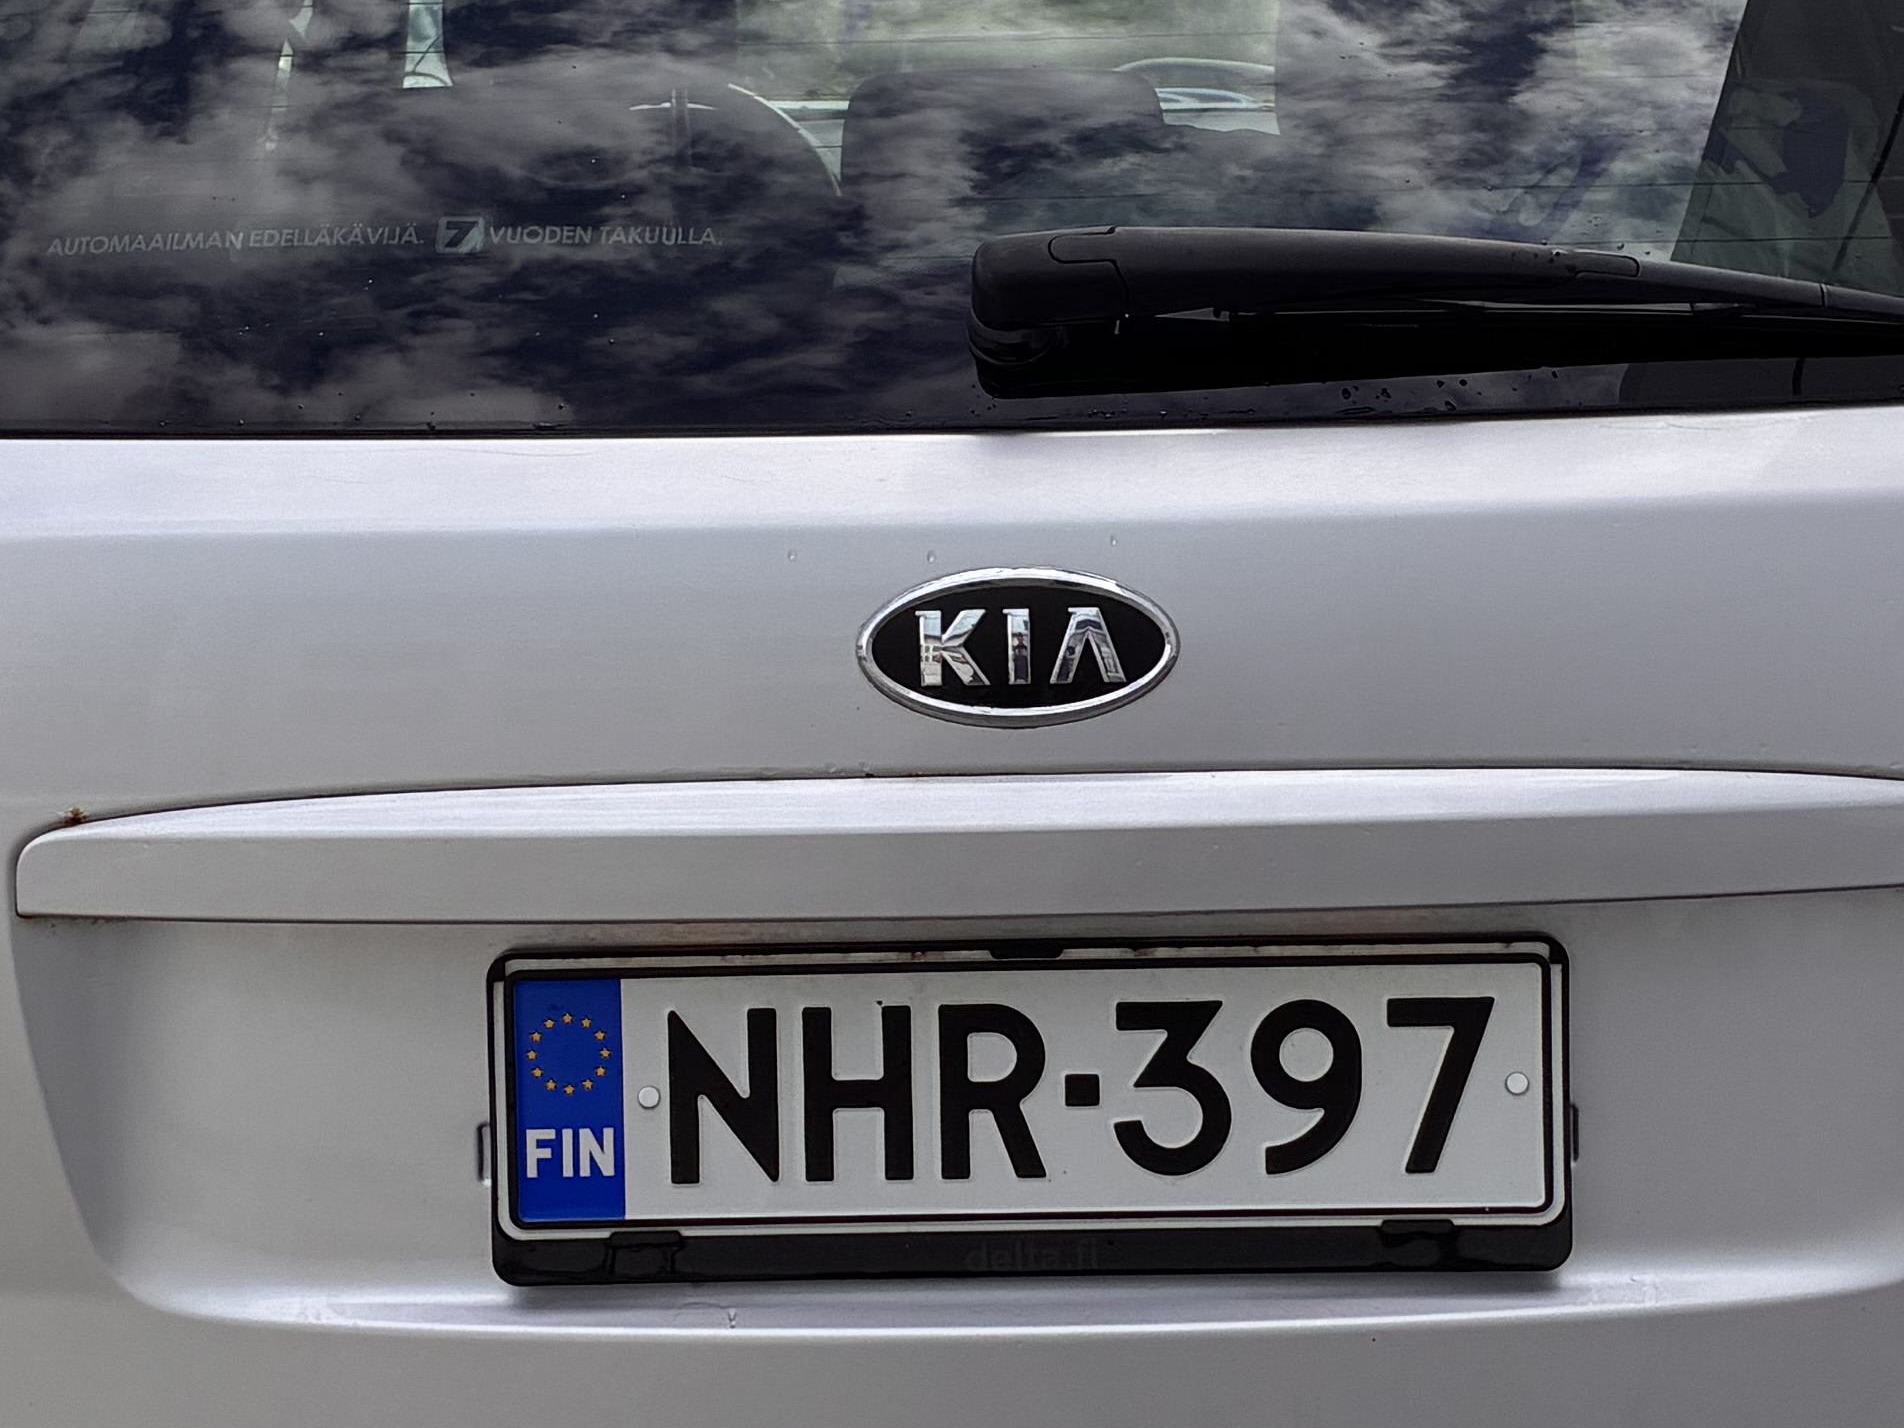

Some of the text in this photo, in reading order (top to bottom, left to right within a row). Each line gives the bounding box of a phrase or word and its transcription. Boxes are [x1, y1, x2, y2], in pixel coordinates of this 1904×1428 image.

[47, 231, 244, 256] AUTOMAAILMAN
[248, 222, 424, 248] EDELLÄKÄVIJÄ.
[489, 225, 593, 245] VUODEN
[599, 225, 723, 246] TAKUULLA.
[914, 606, 1127, 687] KIA
[666, 995, 1495, 1185] NHR-397
[526, 1127, 615, 1178] FIN
[964, 1239, 1098, 1271] delta.fi
